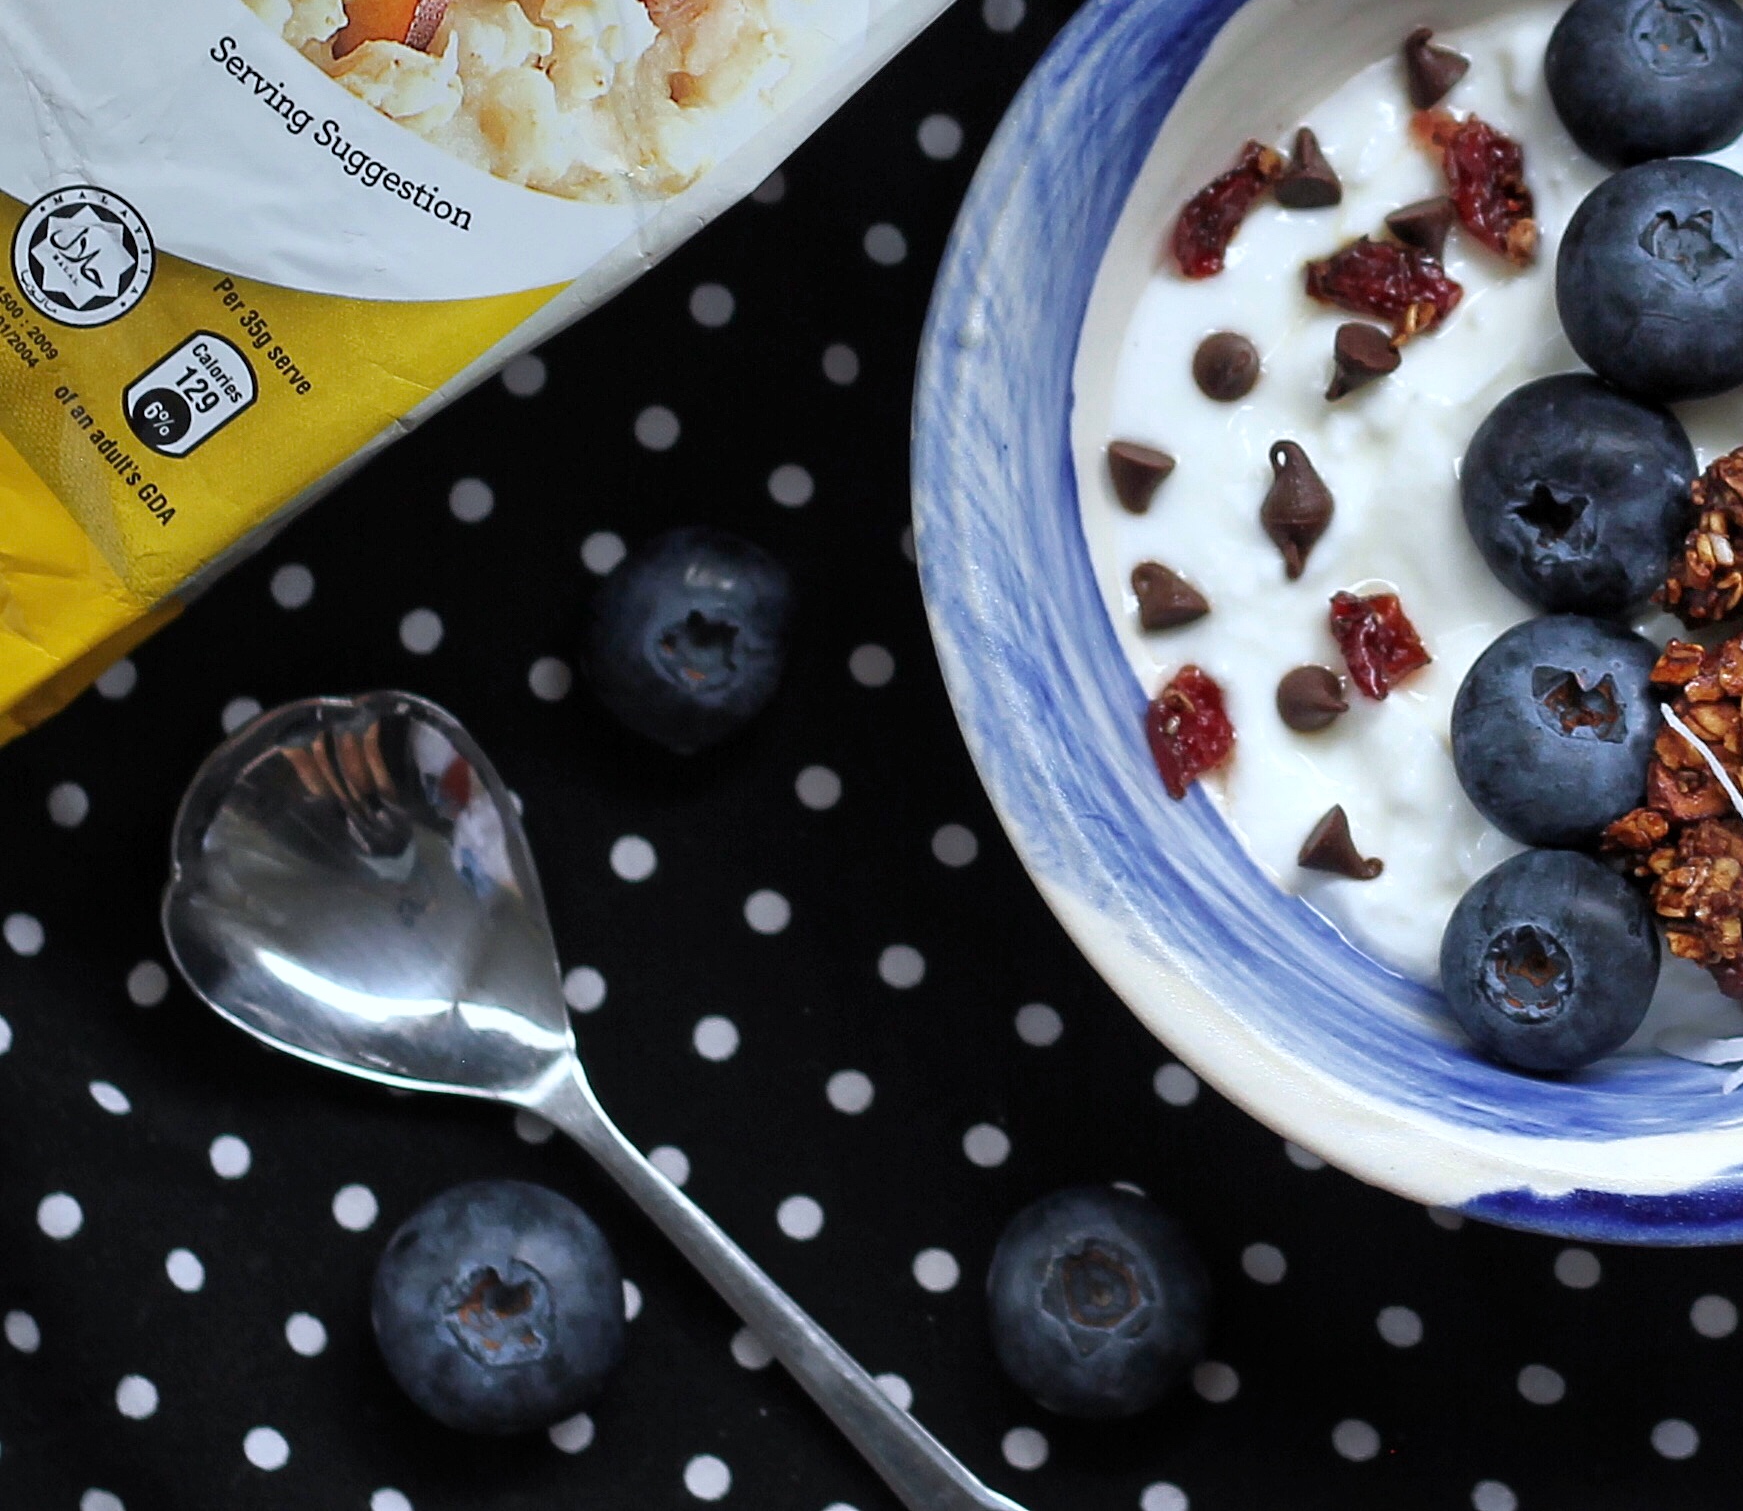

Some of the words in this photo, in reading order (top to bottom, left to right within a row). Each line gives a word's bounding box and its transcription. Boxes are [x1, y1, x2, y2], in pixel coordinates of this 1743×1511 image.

[209, 36, 314, 135] Serving
[314, 120, 473, 232] Suggestion
[53, 191, 149, 296] MALAYSIA
[27, 326, 58, 360] 2009
[192, 343, 243, 404] Calories
[213, 277, 245, 313] Per
[239, 310, 272, 349] 35g
[267, 346, 312, 395] serve
[144, 401, 175, 436] 6%
[175, 366, 220, 414] 129
[54, 386, 79, 405] of
[70, 405, 94, 430] an
[89, 430, 141, 486] adult's
[138, 483, 176, 526] GDA
